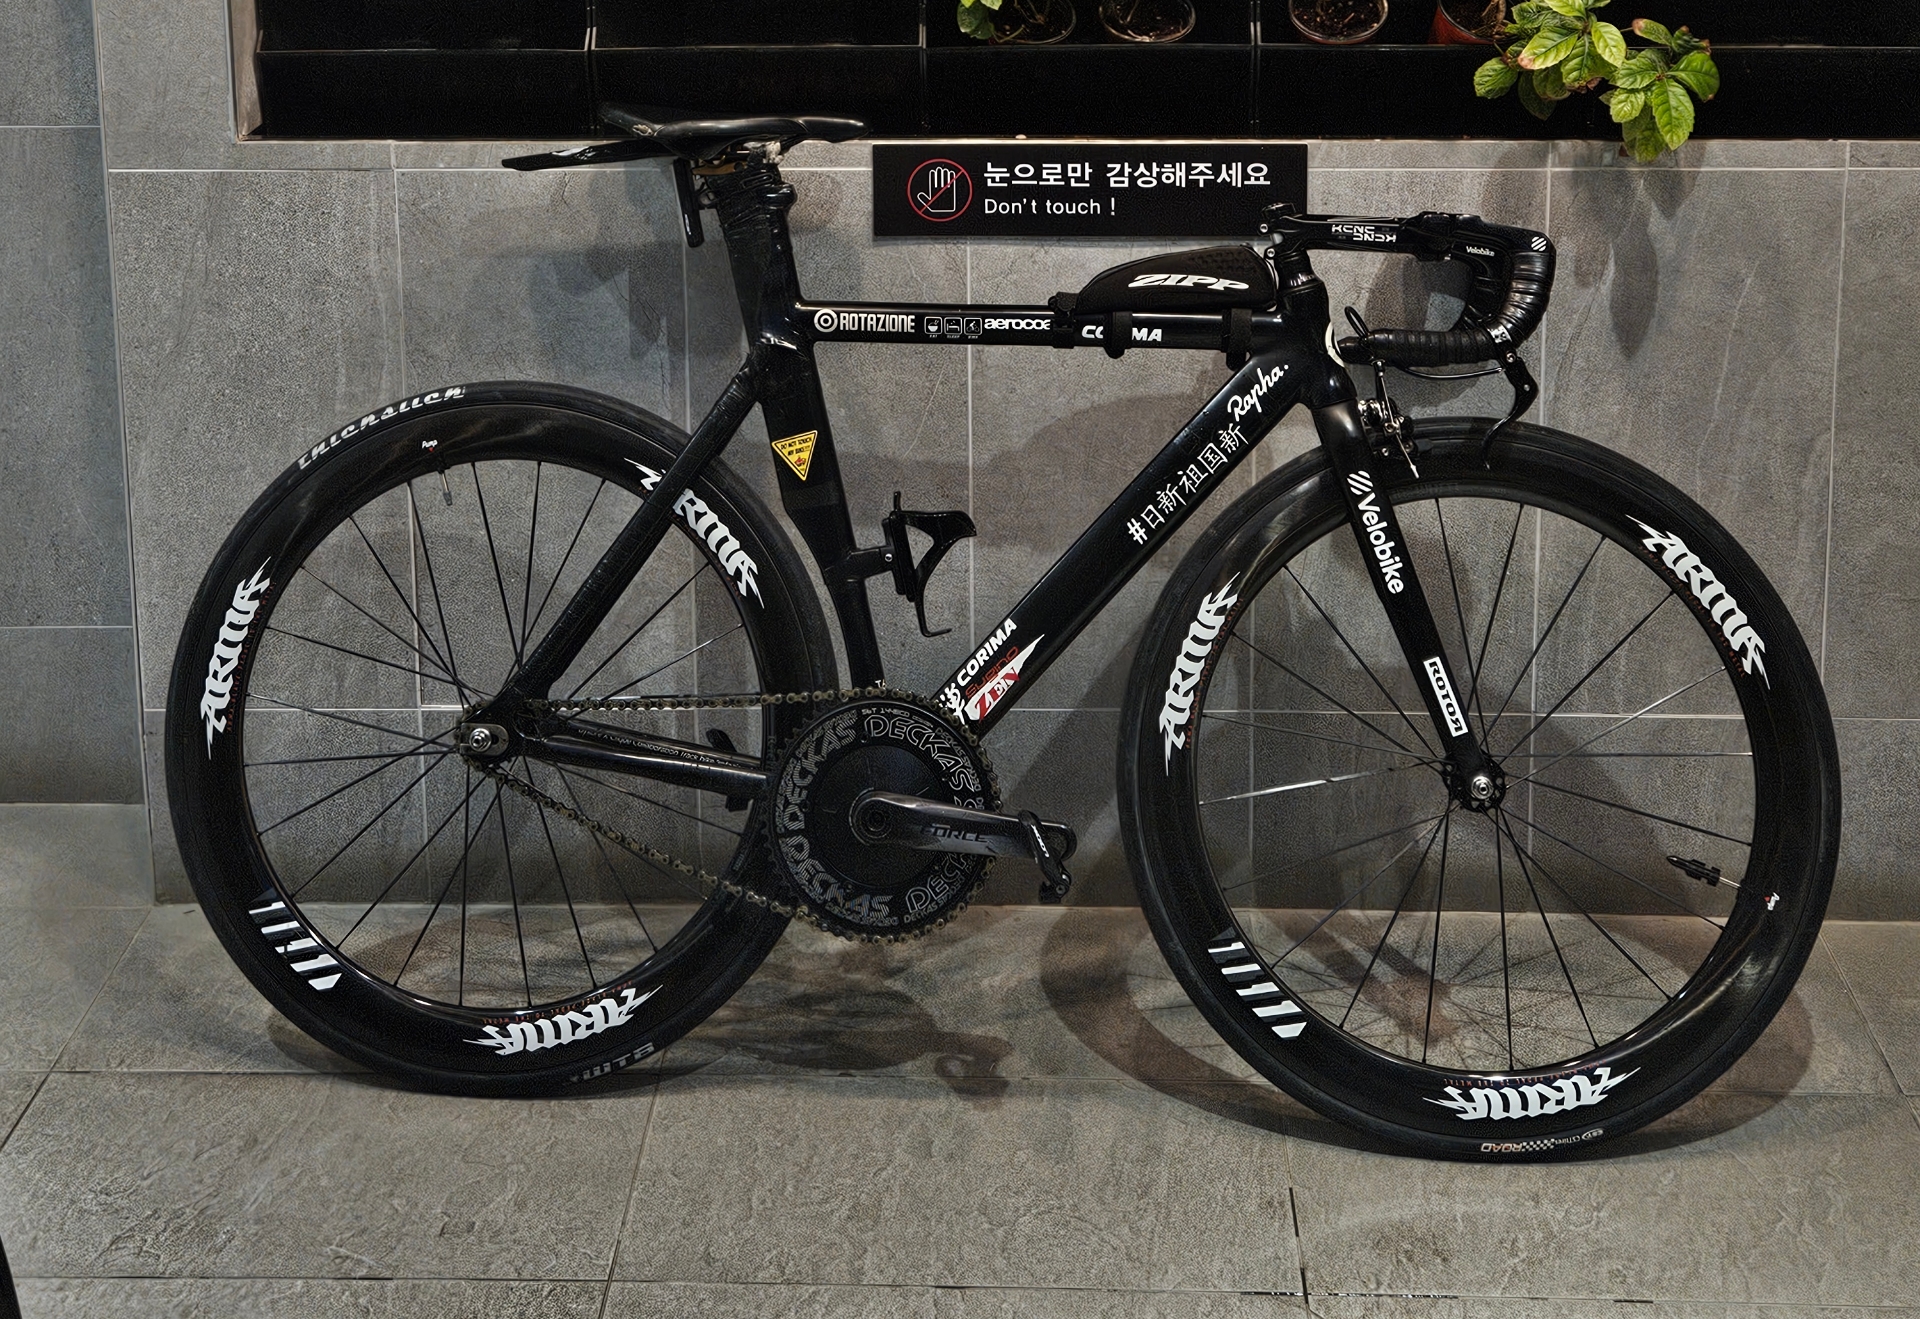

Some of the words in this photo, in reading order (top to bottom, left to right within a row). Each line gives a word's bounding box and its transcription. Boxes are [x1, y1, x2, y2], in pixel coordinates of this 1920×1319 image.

[984, 162, 1092, 187] 눈으로만
[1106, 162, 1271, 188] 감상해주세요
[984, 199, 1038, 215] Don't
[1045, 198, 1100, 215] touch
[1331, 224, 1375, 234] KCNC
[1127, 273, 1250, 291] ZIPP
[839, 312, 916, 333] ROTAZIONE
[1358, 492, 1404, 594] Velobike
[956, 618, 1018, 687] CORIMA
[1427, 660, 1464, 733] ROTOR
[864, 714, 975, 793] DECKAS
